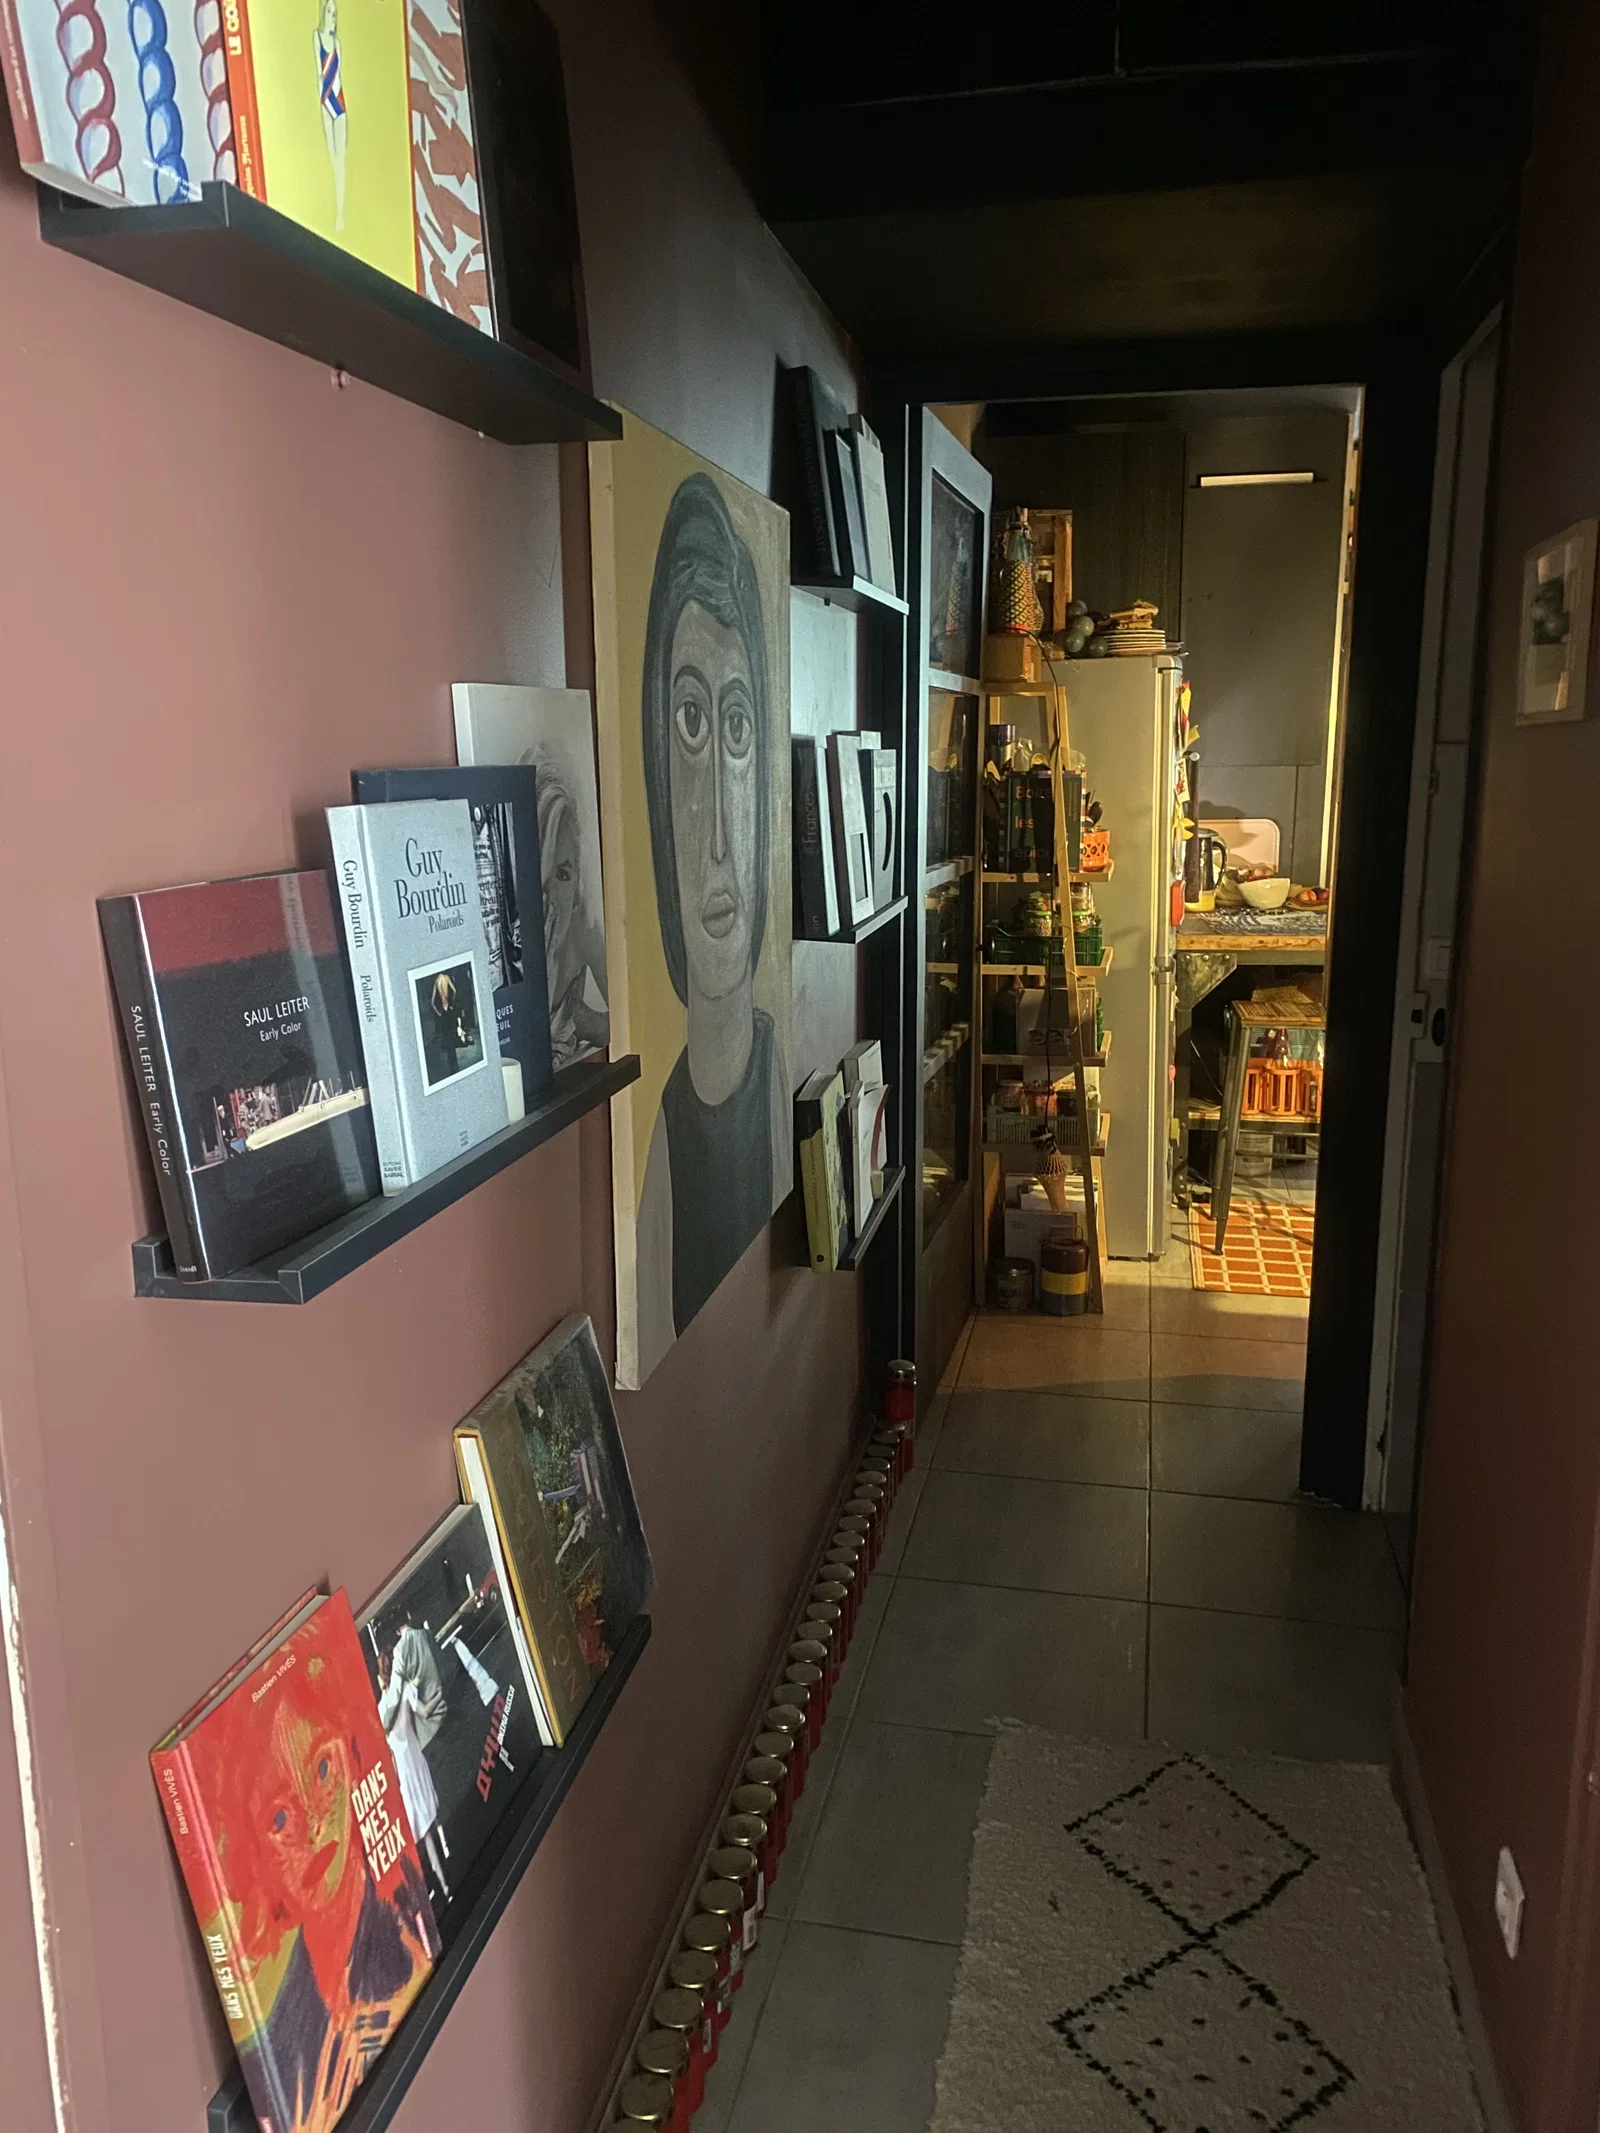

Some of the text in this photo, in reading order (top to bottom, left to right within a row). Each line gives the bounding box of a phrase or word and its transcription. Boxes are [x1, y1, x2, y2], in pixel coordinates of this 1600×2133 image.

[228, 35, 242, 56] LE
[405, 837, 443, 886] Guy
[393, 870, 468, 919] Bourdin
[341, 860, 377, 1023] Guy Bourdin Polaroids
[428, 908, 465, 933] Polaroids
[244, 996, 310, 1027] SAUL LEITER
[259, 1021, 302, 1042] Early Color
[496, 1004, 514, 1020] QUES
[131, 1005, 171, 1176] SAUL LEITER Early Color
[252, 1675, 277, 1703] Bastien
[503, 1684, 515, 1716] RUSSA
[351, 1760, 388, 1823] DANS
[176, 1798, 189, 1835] Bastien
[359, 1798, 390, 1854] MES
[367, 1817, 407, 1882] YEUX
[207, 1933, 244, 2020] DANS MES YEUX
